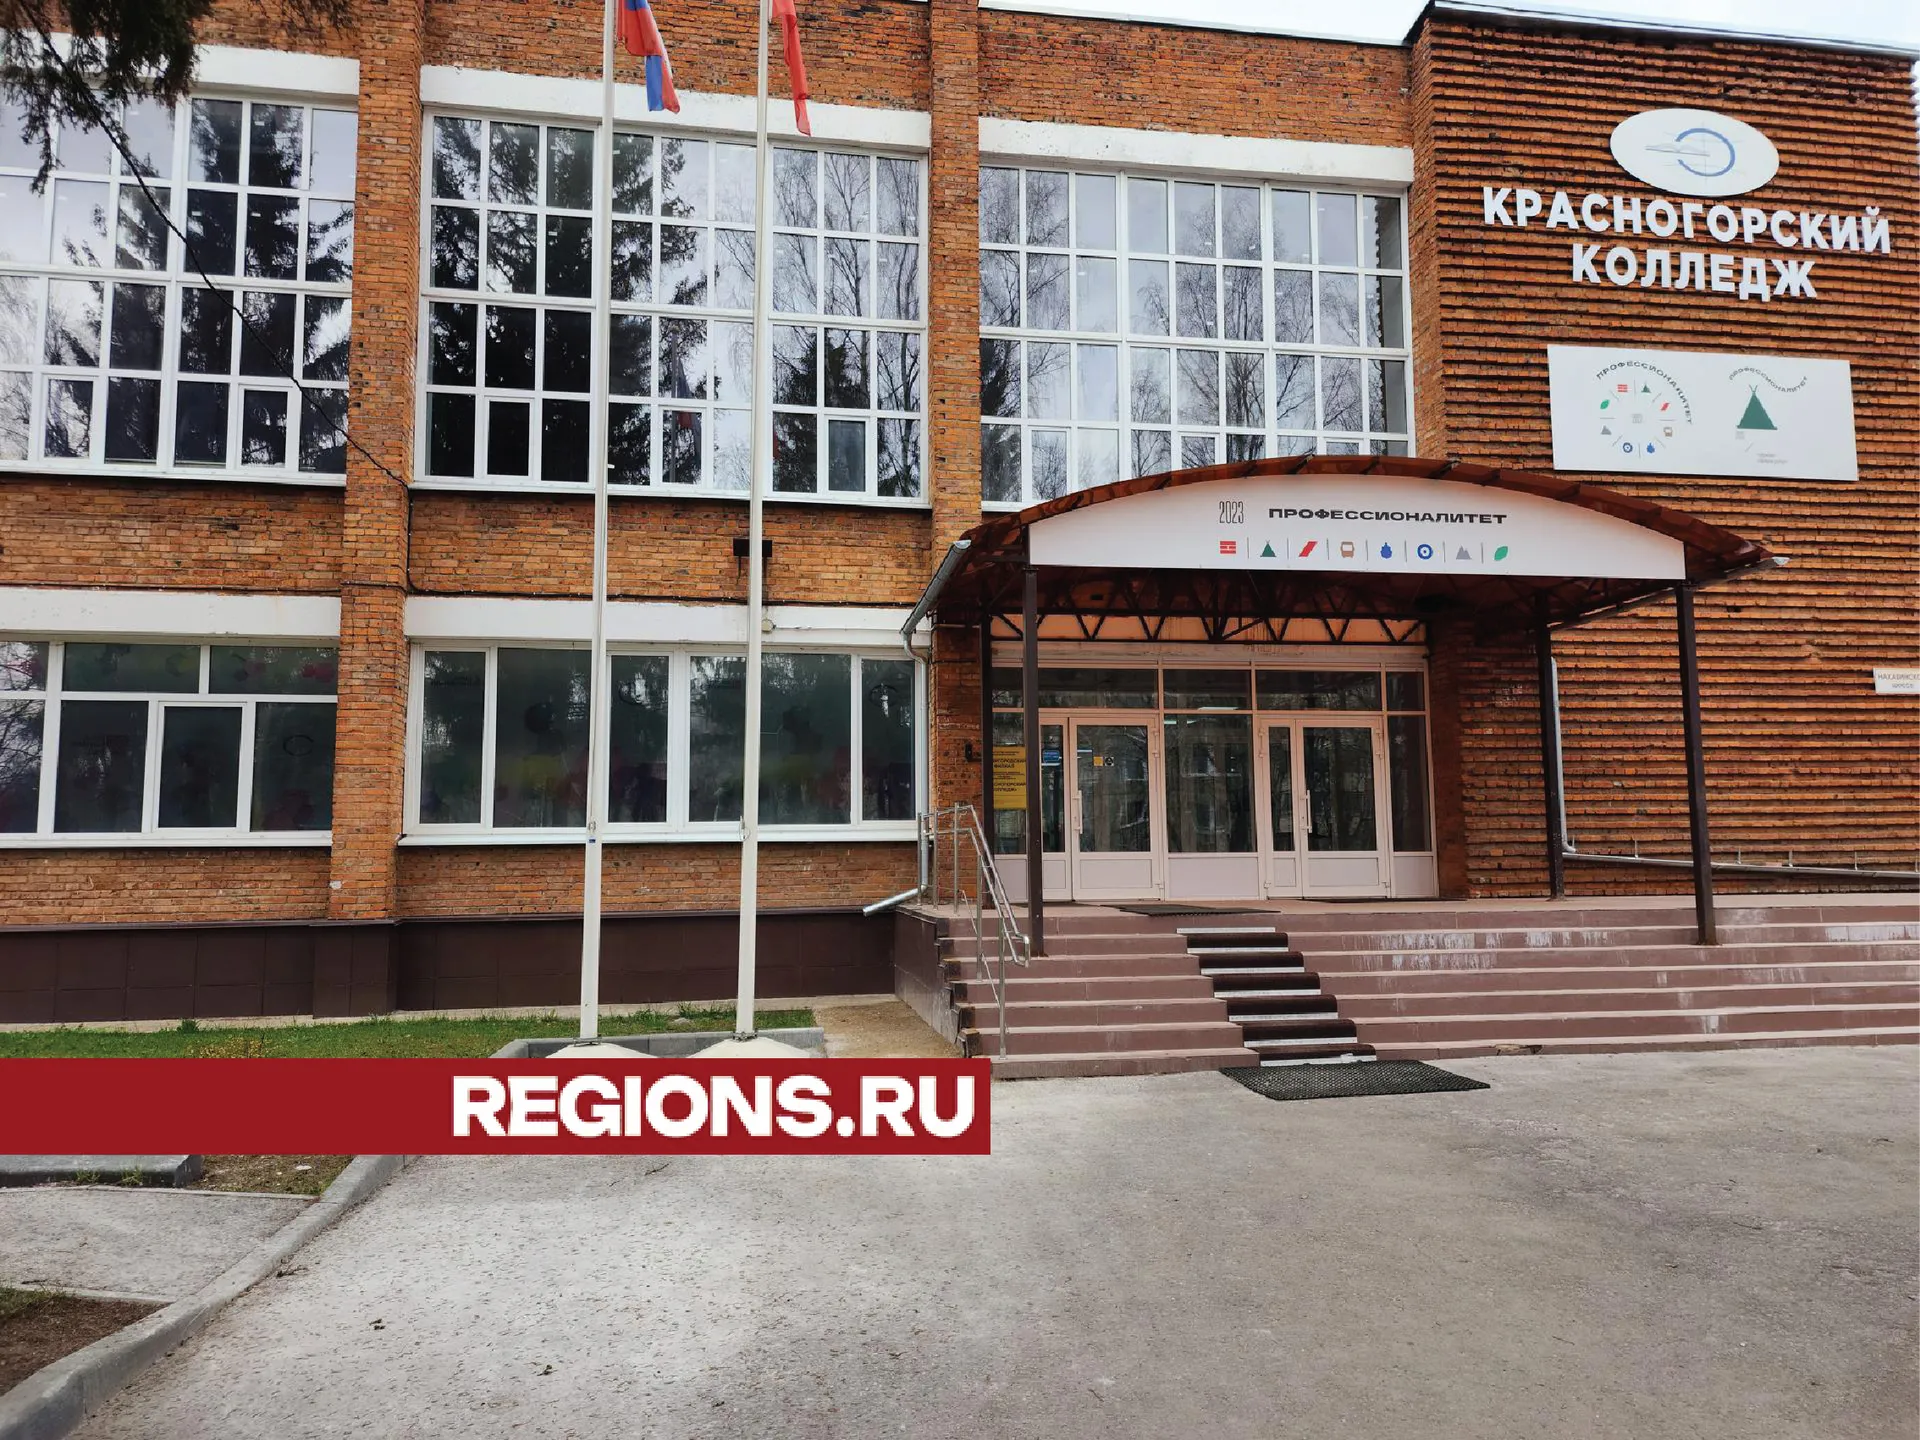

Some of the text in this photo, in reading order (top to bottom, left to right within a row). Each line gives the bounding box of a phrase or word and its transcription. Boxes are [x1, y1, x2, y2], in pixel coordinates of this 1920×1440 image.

[1483, 186, 1891, 254] КРАСНОГОРСКИЙ
[1572, 243, 1818, 301] КОЛЛЕДЖ
[1596, 360, 1693, 425] ПРОФЕССИОНАЛИТЕТ
[1219, 500, 1507, 524] 2023 ПРОФЕССИОНАЛИТЕТ
